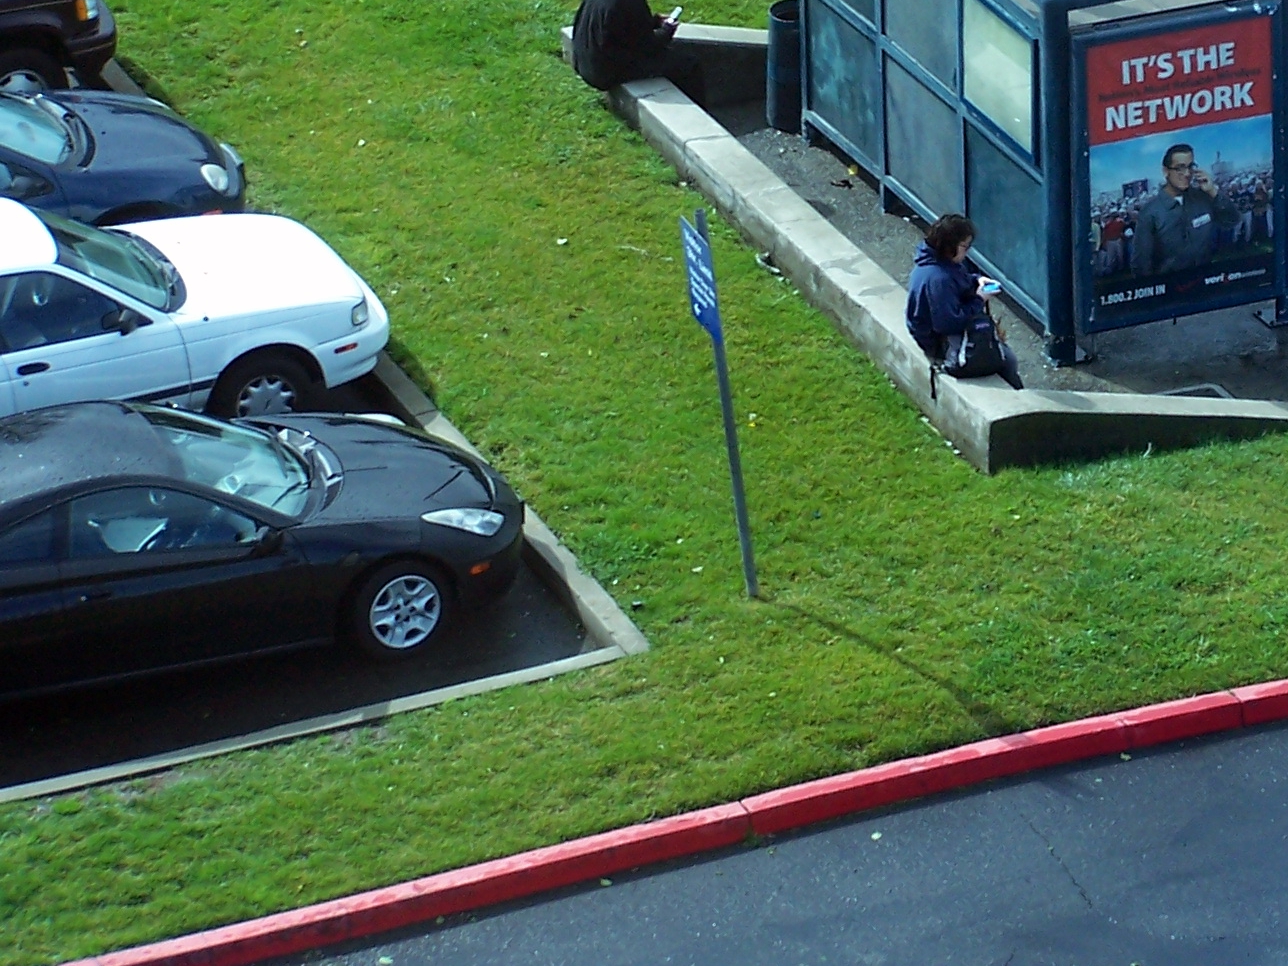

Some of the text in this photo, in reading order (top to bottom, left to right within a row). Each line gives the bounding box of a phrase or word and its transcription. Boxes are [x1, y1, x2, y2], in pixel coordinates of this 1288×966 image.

[1121, 52, 1175, 85] IT'S
[1177, 42, 1235, 75] THE
[1105, 81, 1254, 132] NETWORK
[1134, 286, 1154, 300] JOIN
[1155, 284, 1166, 296] IN
